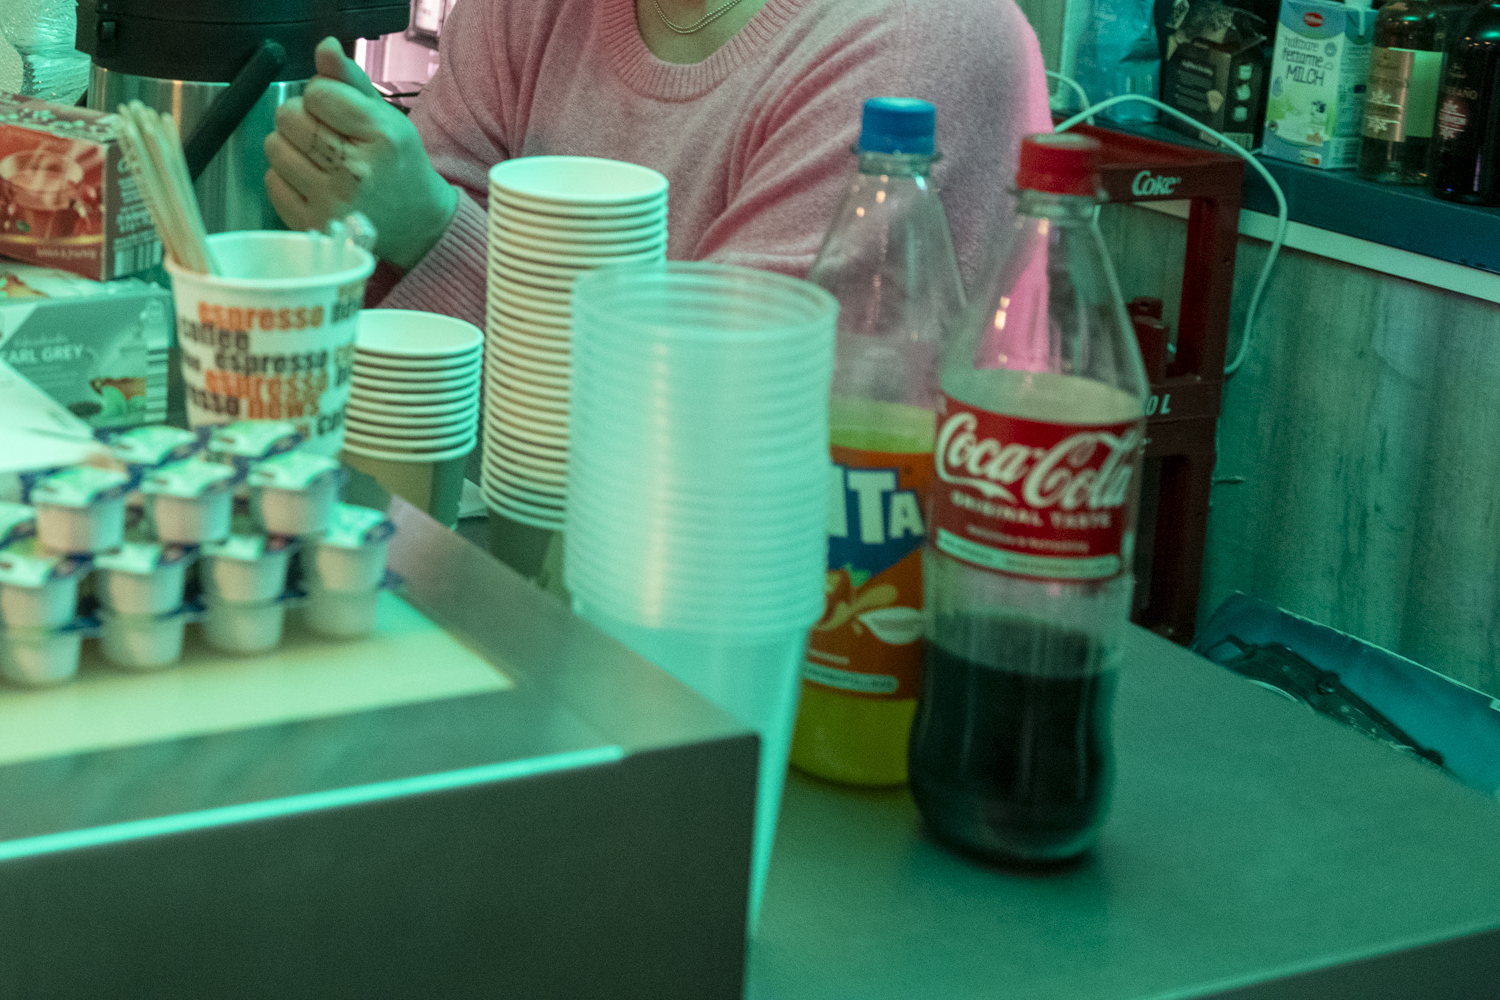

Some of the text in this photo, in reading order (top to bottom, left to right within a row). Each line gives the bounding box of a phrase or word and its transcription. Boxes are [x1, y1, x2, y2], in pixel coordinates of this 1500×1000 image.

[1285, 65, 1326, 87] MILCH
[1131, 170, 1177, 197] Coke
[198, 302, 324, 332] espresso
[41, 344, 84, 363] GREY
[215, 350, 328, 376] espresso
[934, 411, 1140, 510] Coca-Cola
[829, 465, 926, 545] TA
[951, 489, 1112, 529] ORIGINAL TASTE
